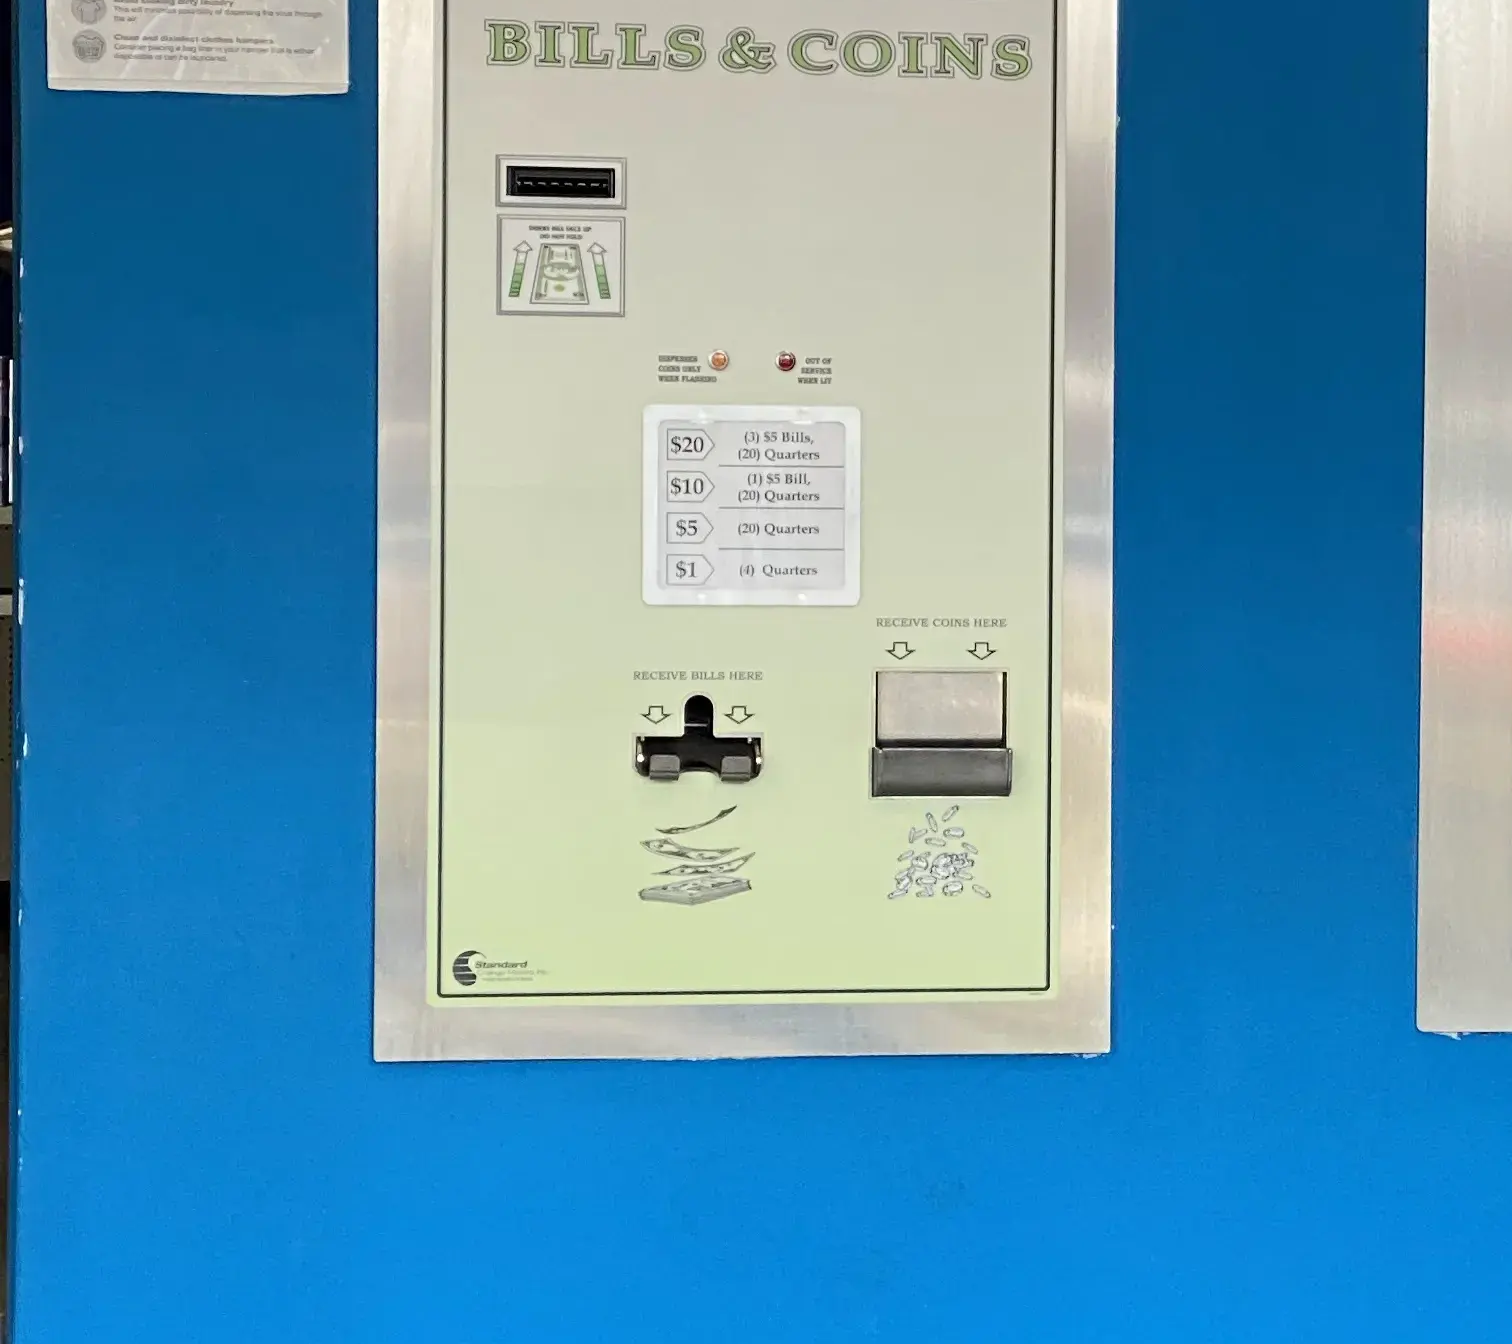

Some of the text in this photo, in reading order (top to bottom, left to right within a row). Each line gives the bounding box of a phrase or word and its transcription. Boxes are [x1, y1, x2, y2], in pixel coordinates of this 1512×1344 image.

[484, 18, 1034, 82] BILLS & COINS
[670, 435, 705, 454] $20
[743, 430, 815, 445] (3) $5 Bills,
[737, 448, 820, 462] (20) Quarters
[670, 477, 705, 496] $10
[747, 472, 811, 487] (1) $5 Bill,
[737, 490, 820, 504] (20) Quarters
[675, 519, 698, 538] $5
[737, 523, 820, 537] (20) Quarters
[675, 560, 698, 579] $1
[739, 564, 818, 578] (4) Quarters
[876, 617, 1008, 629] RECEIVE COINS HERE
[633, 670, 763, 682] RECEIVE BILLS HERE
[475, 961, 528, 969] Standard
